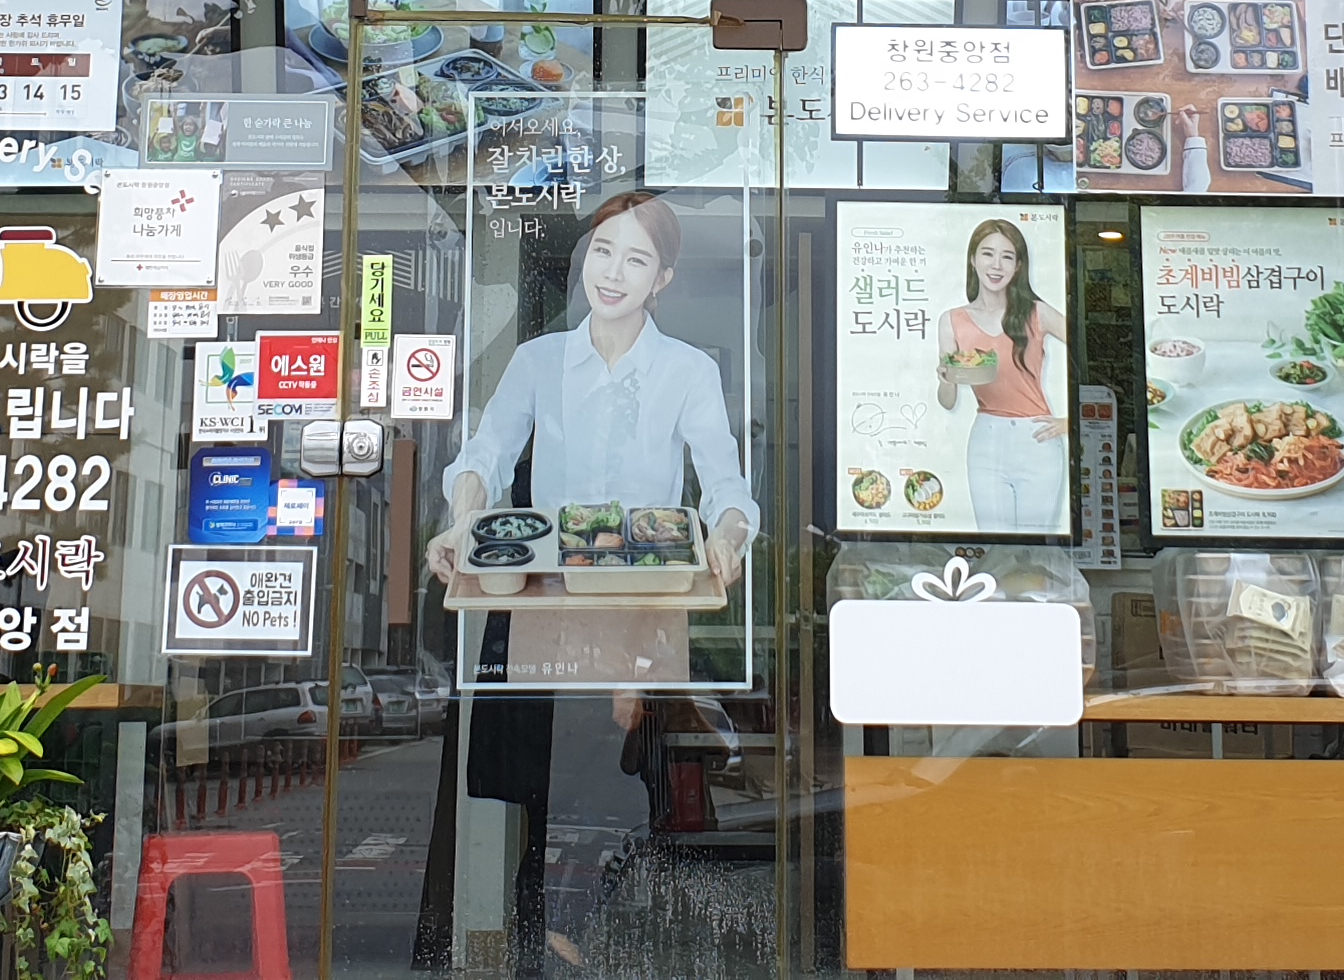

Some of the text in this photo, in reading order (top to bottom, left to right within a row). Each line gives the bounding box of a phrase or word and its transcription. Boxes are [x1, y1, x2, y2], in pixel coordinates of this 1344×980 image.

[16, 13, 42, 28] 추석
[46, 13, 85, 28] 휴무일
[885, 38, 1013, 65] 창원중앙점
[790, 65, 825, 86] 한식
[883, 70, 1016, 94] 263-4282
[22, 83, 45, 101] 14
[59, 84, 82, 102] 15
[850, 101, 944, 126] Delivery
[955, 102, 1050, 125] Service
[485, 181, 587, 211] 본도시락
[133, 207, 176, 221] 희망풍차
[132, 223, 182, 238] 나눔가게
[489, 218, 546, 239] 입니다.
[288, 265, 314, 278] 우수
[1156, 263, 1325, 291] 초계비빔삼겹구이
[262, 280, 314, 289] VERY GOOD
[367, 260, 387, 324] 당기세요
[848, 274, 930, 307] 샐러드
[1157, 292, 1225, 319] 도시락
[849, 308, 931, 341] 도시락
[364, 331, 388, 341] PULL
[270, 354, 325, 377] 에스원
[278, 380, 298, 389] CCTV
[367, 368, 382, 404] 손조심
[401, 386, 444, 398] 금연시설
[257, 403, 303, 416] SECOM
[249, 571, 293, 590] 애완견
[242, 589, 298, 607] 출입금지
[242, 610, 260, 628] NO
[541, 661, 579, 676] 유인나
